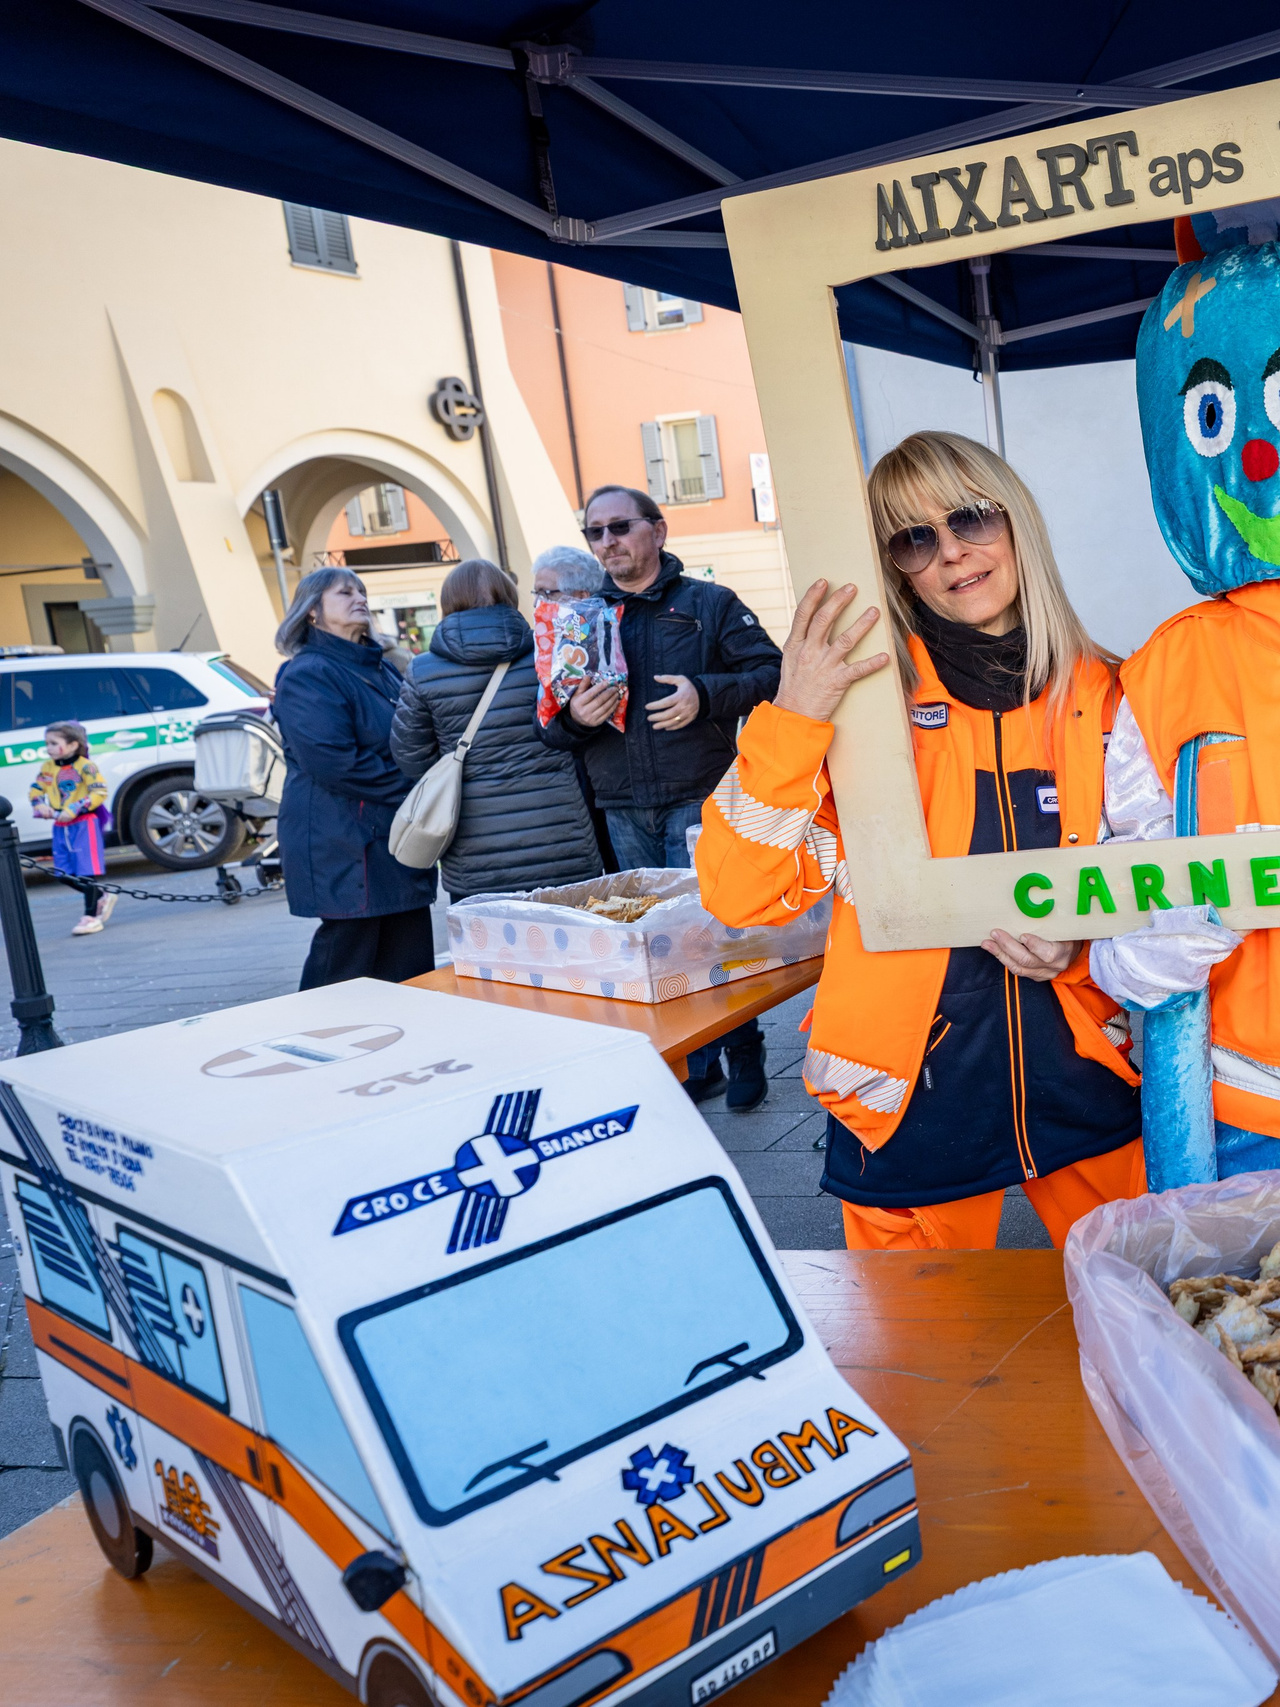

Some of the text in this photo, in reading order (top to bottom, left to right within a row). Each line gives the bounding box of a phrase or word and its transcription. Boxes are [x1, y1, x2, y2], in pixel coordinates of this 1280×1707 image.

[875, 130, 1139, 251] MIXART
[1148, 142, 1244, 204] aps
[538, 1120, 625, 1157] BIANCA
